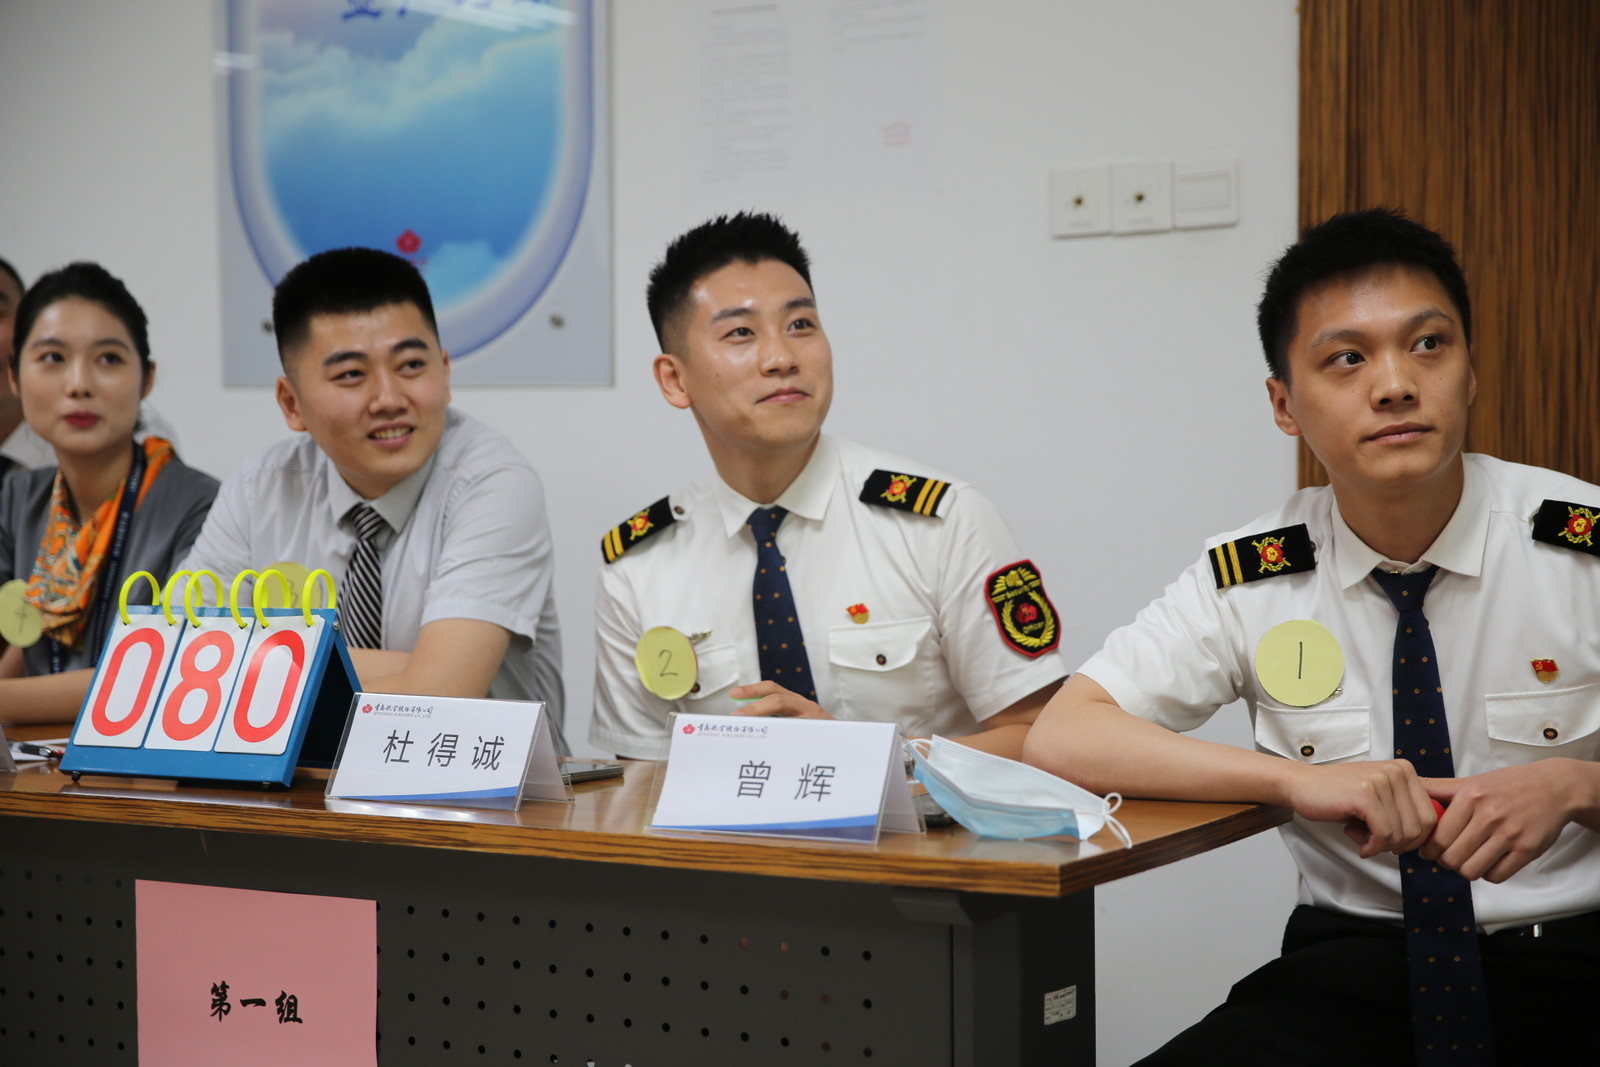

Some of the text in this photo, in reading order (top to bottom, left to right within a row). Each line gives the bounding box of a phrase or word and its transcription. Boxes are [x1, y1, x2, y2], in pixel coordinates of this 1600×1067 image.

[658, 648, 679, 677] 2
[1297, 641, 1303, 680] 1
[91, 627, 305, 743] 080
[383, 729, 505, 771] 杜得诚
[737, 760, 836, 802] 曾辉
[210, 981, 303, 1024] 第一组
